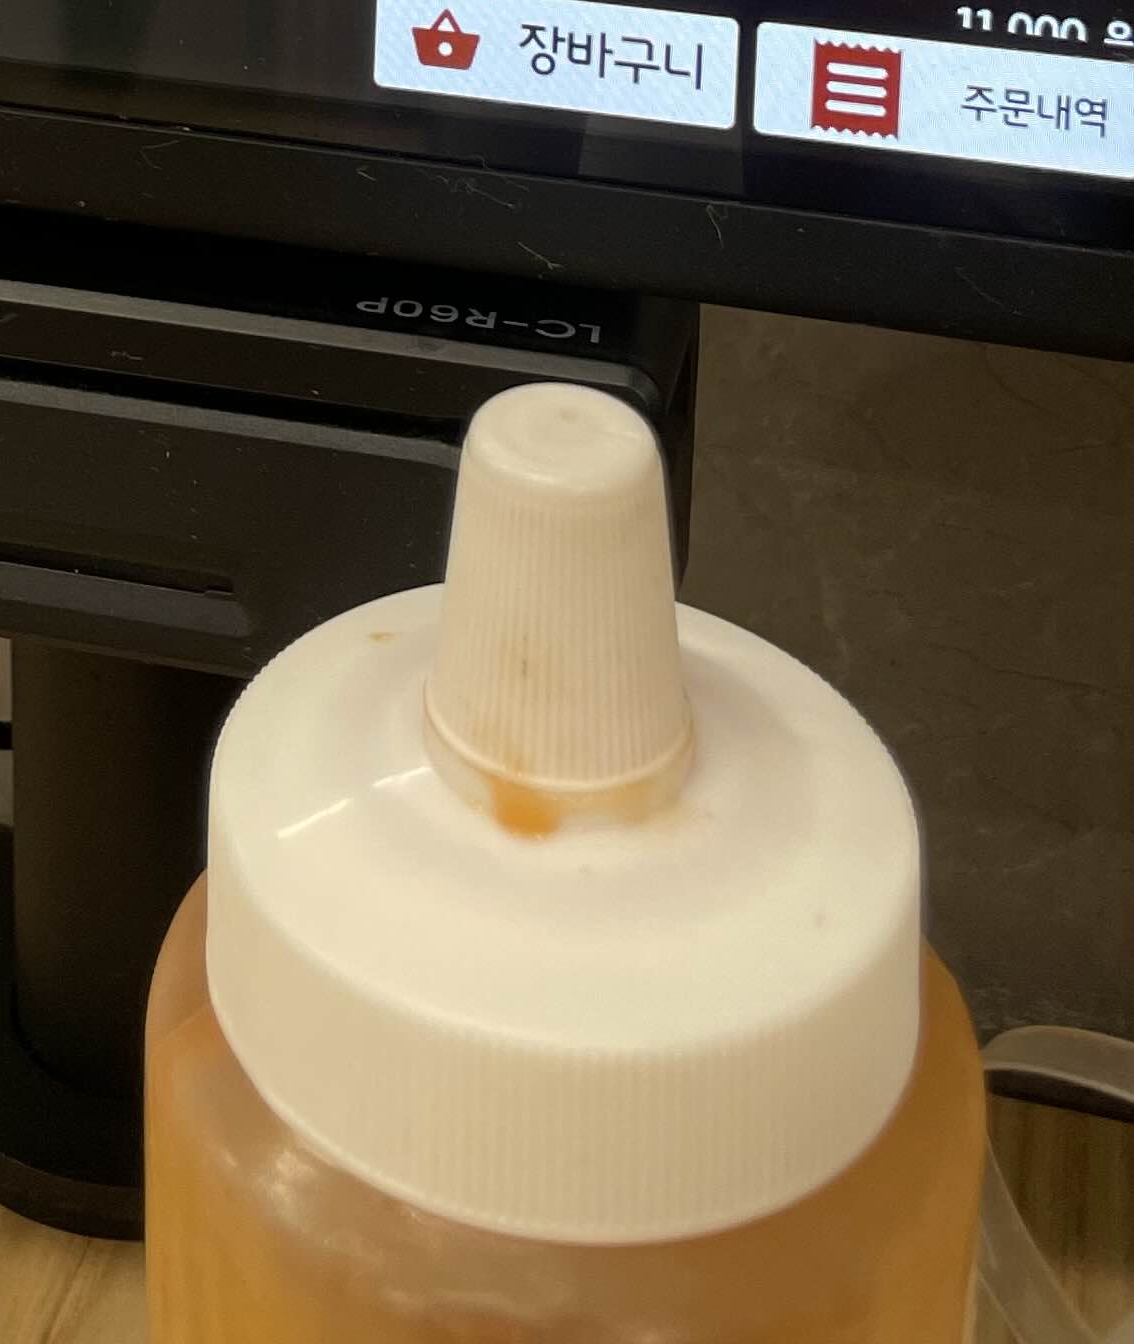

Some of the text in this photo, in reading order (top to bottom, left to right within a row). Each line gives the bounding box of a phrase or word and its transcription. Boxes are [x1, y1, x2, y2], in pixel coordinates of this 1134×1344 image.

[518, 22, 704, 91] 장바구니
[960, 83, 1109, 140] 주문내역
[355, 296, 602, 344] LC-R60P
